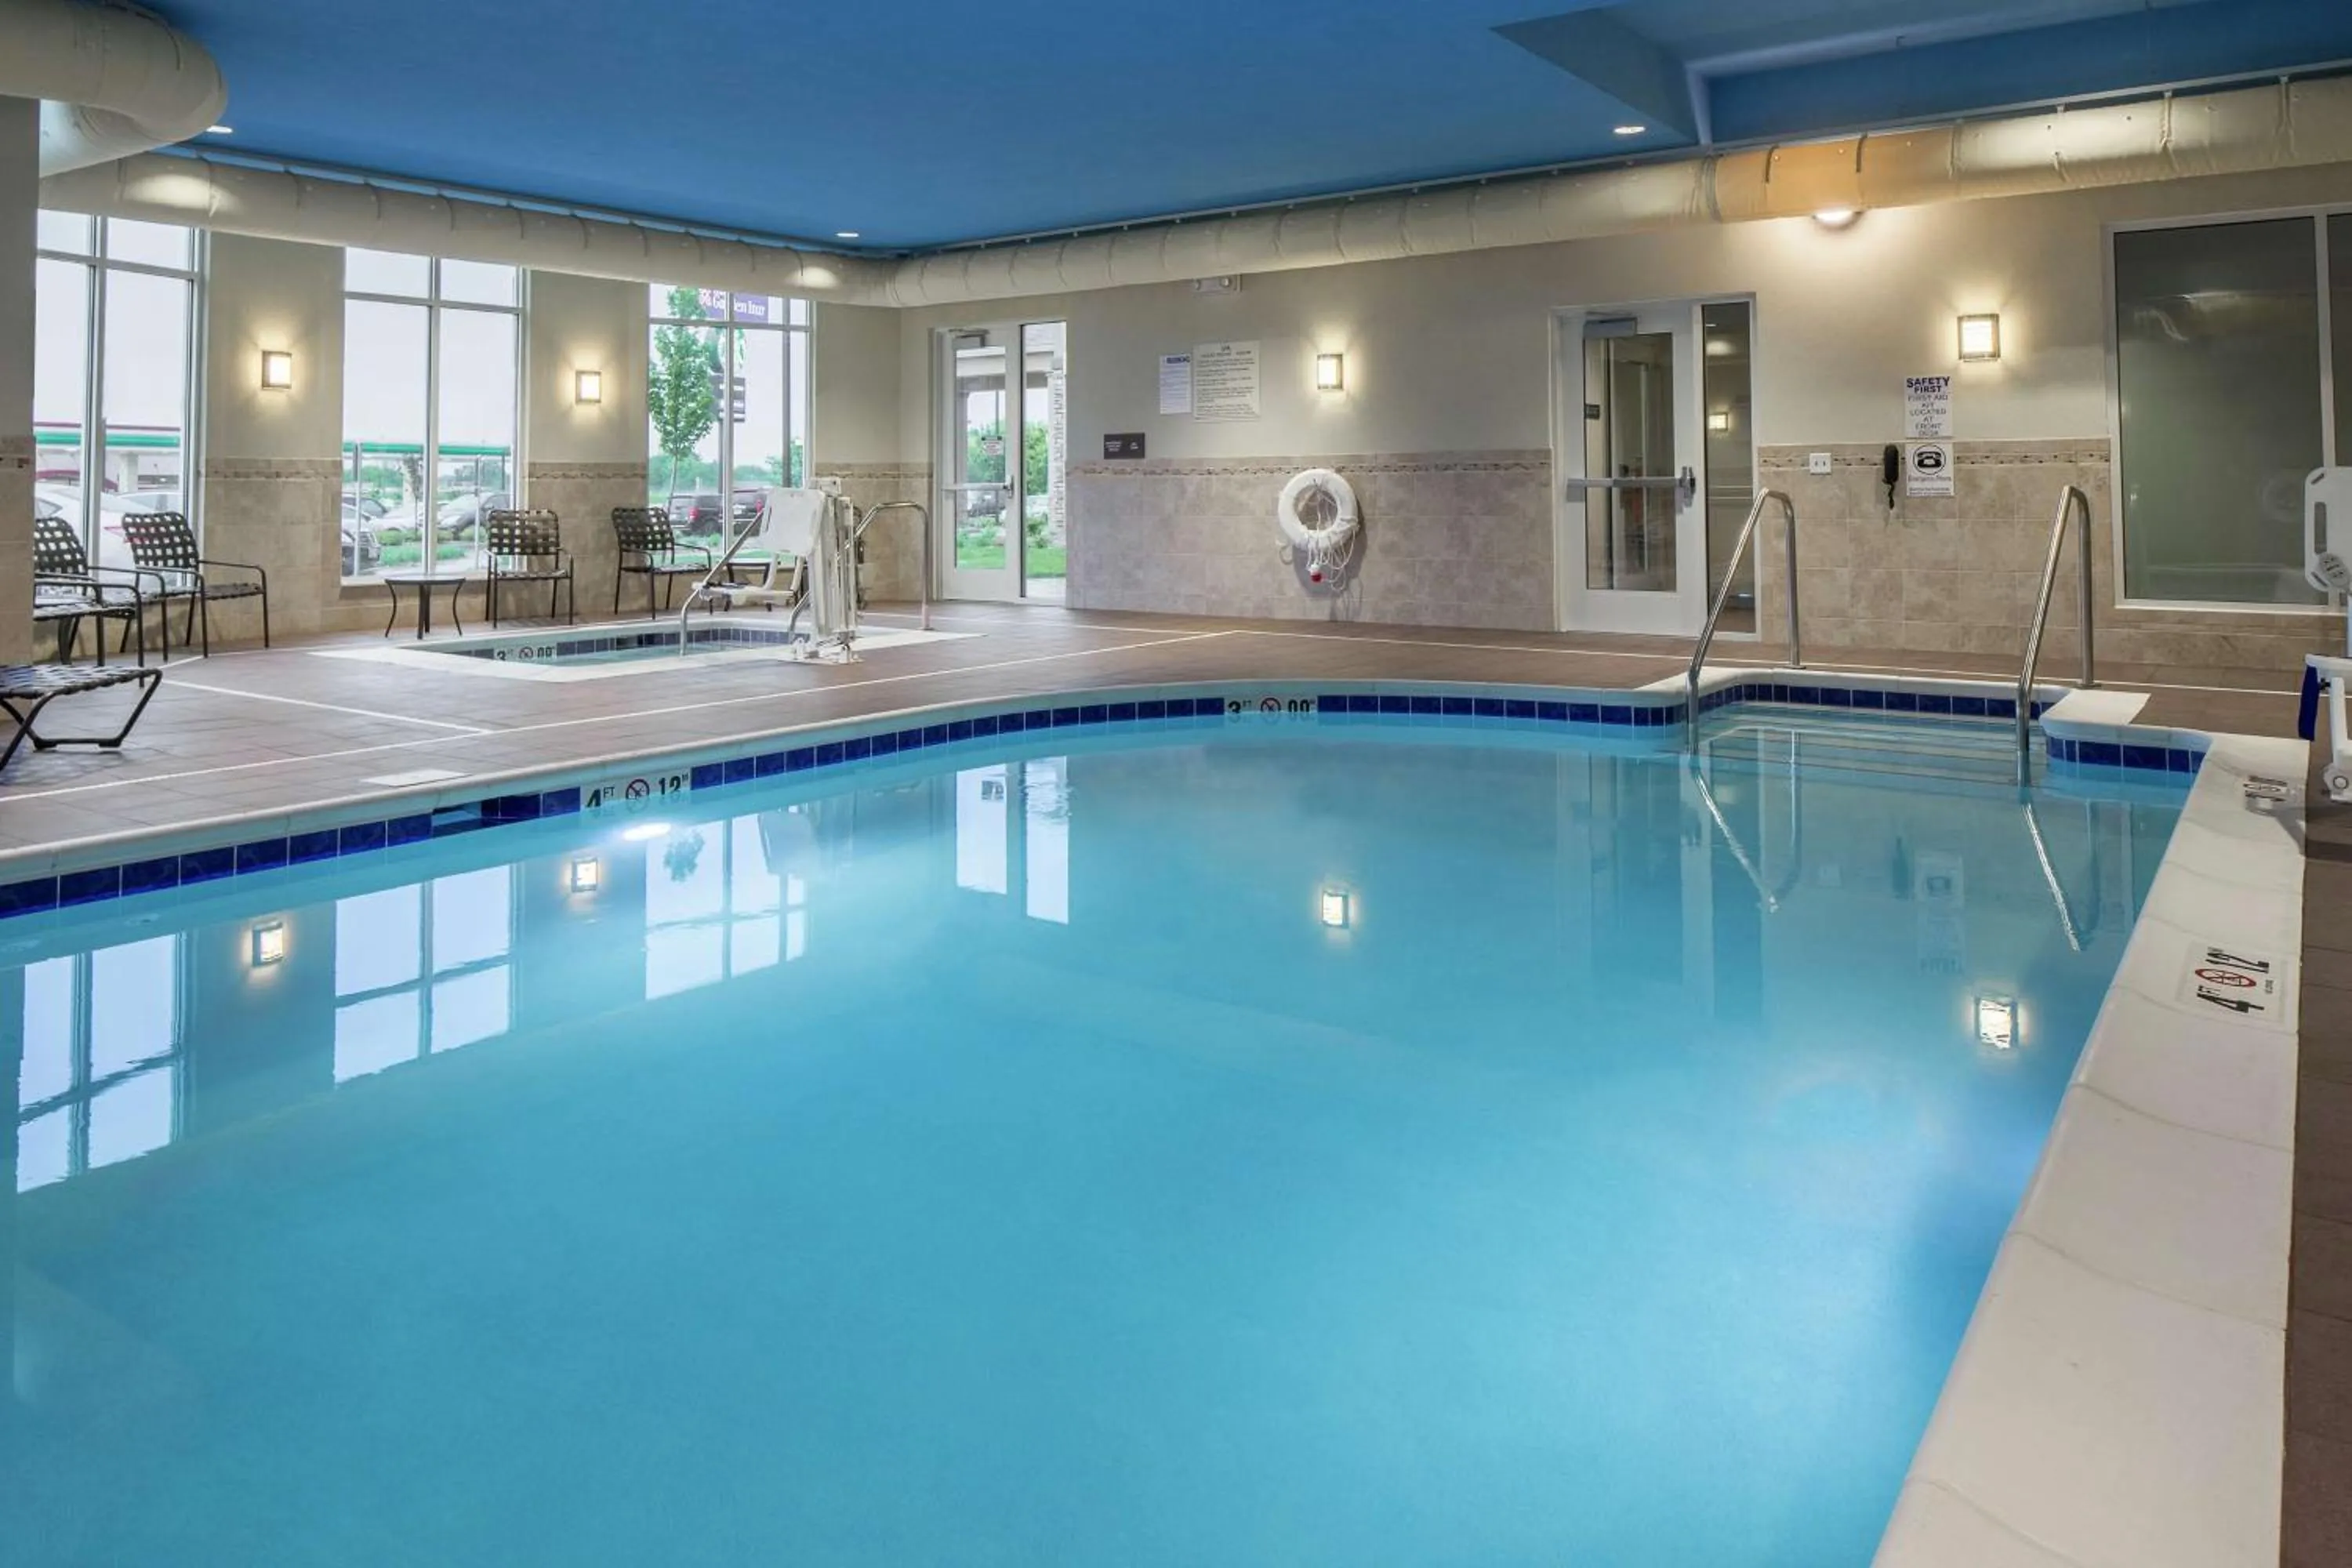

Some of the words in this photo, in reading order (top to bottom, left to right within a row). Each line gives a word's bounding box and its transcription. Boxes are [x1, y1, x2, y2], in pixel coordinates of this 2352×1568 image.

[748, 300, 765, 316] Inn
[1907, 376, 1950, 388] SAFETY
[1915, 385, 1941, 394] FIRST
[603, 786, 615, 798] FT
